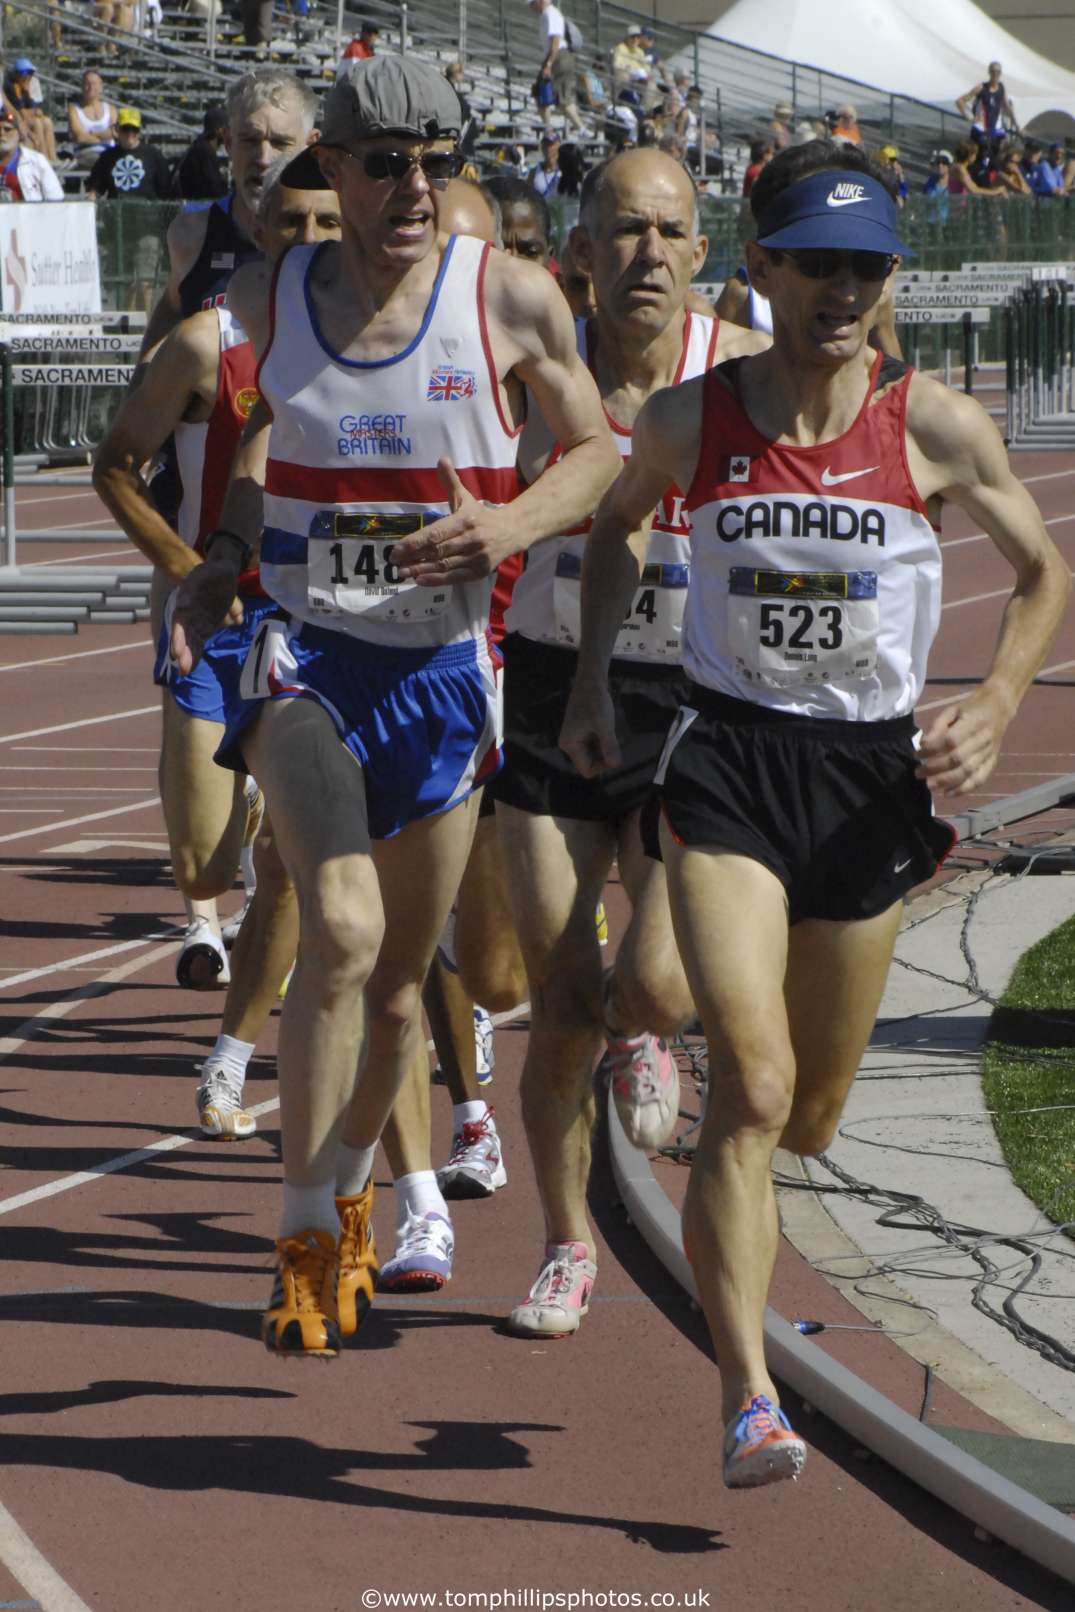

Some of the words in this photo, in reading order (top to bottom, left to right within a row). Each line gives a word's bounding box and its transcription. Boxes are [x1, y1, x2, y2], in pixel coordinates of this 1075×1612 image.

[834, 183, 865, 199] NIKE
[935, 284, 1008, 293] SACRAMENTO
[896, 295, 978, 305] SACRAMENTO
[0, 314, 91, 325] SACRAMENTO
[11, 337, 122, 350] SACRAMENTO
[21, 368, 135, 383] SACRAMEN
[339, 415, 407, 433] GREAT
[337, 438, 412, 455] BRITAIN
[716, 502, 885, 547] CANADA
[760, 604, 843, 650] 523
